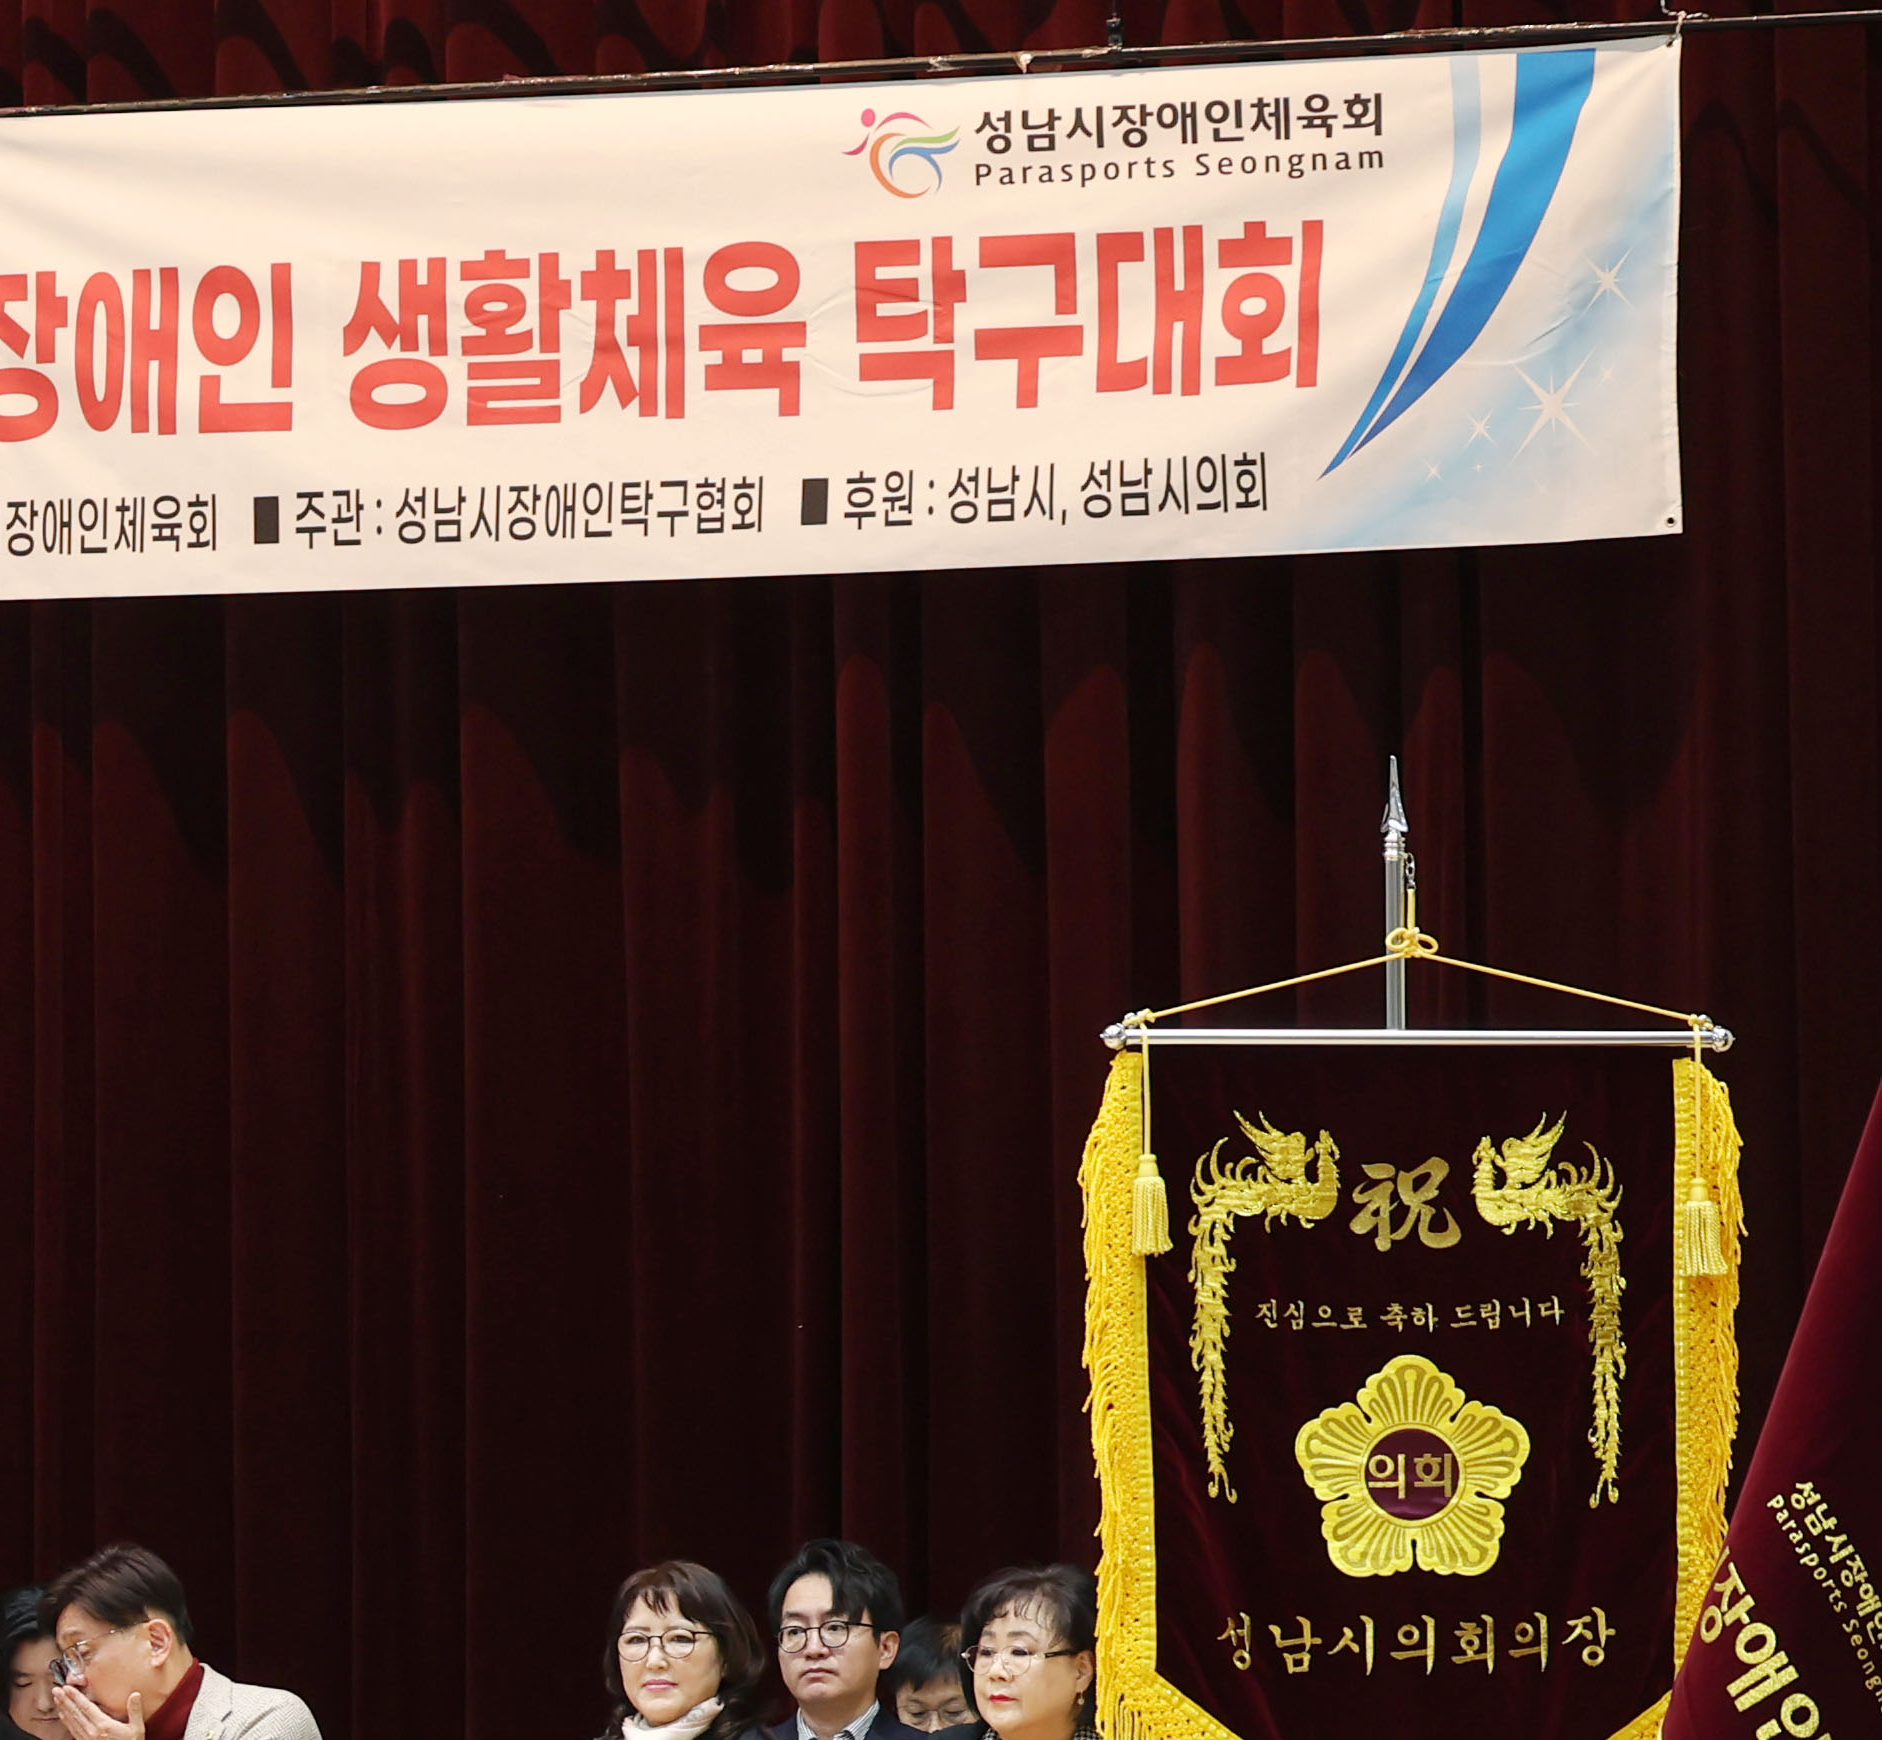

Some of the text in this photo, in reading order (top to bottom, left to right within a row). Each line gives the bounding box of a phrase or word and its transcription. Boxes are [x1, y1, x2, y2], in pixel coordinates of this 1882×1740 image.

[974, 91, 1384, 145] 성남시장애인체육회
[974, 149, 1385, 188] Parasports Seongnam
[342, 241, 808, 431] 생활체육
[853, 219, 1325, 411] 탁구대회
[295, 488, 365, 550] 주관
[395, 475, 764, 545] 성남시장애인탁구협회
[843, 469, 914, 531] 후원
[947, 462, 1067, 527] 성남시,
[1080, 451, 1268, 519] 성남시의회
[1349, 1156, 1462, 1252] 祝
[1256, 1295, 1565, 1333] 진심으로 축하 드립니다
[1367, 1453, 1452, 1500] 의회
[1766, 1493, 1848, 1613] Parasports
[1217, 1606, 1616, 1676] 성남시의회의장
[1842, 1617, 1882, 1713] Seong
